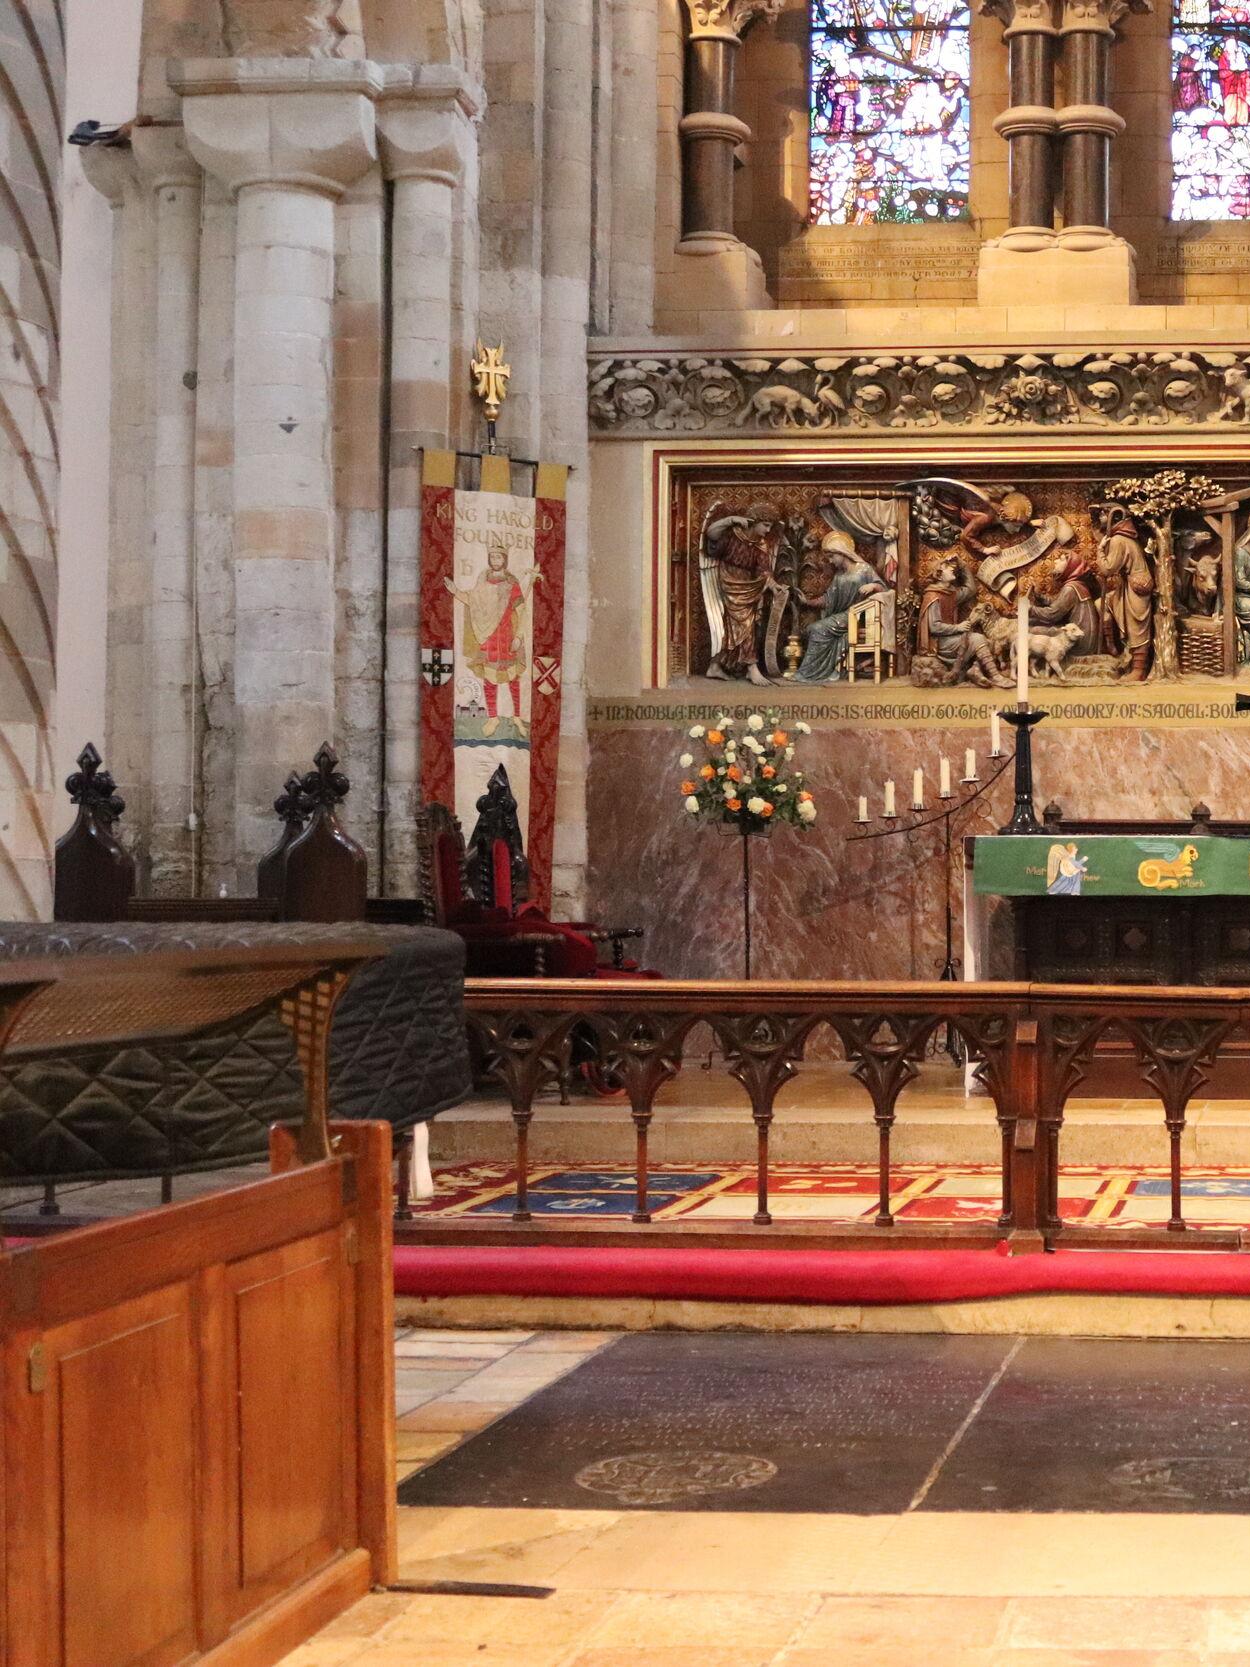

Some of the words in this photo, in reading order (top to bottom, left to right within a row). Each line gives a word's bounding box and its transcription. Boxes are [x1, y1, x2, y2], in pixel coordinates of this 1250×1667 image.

[437, 503, 477, 523] KING
[487, 508, 554, 530] HAROLD
[455, 527, 534, 550] FOUNDER
[1120, 703, 1138, 719] OF
